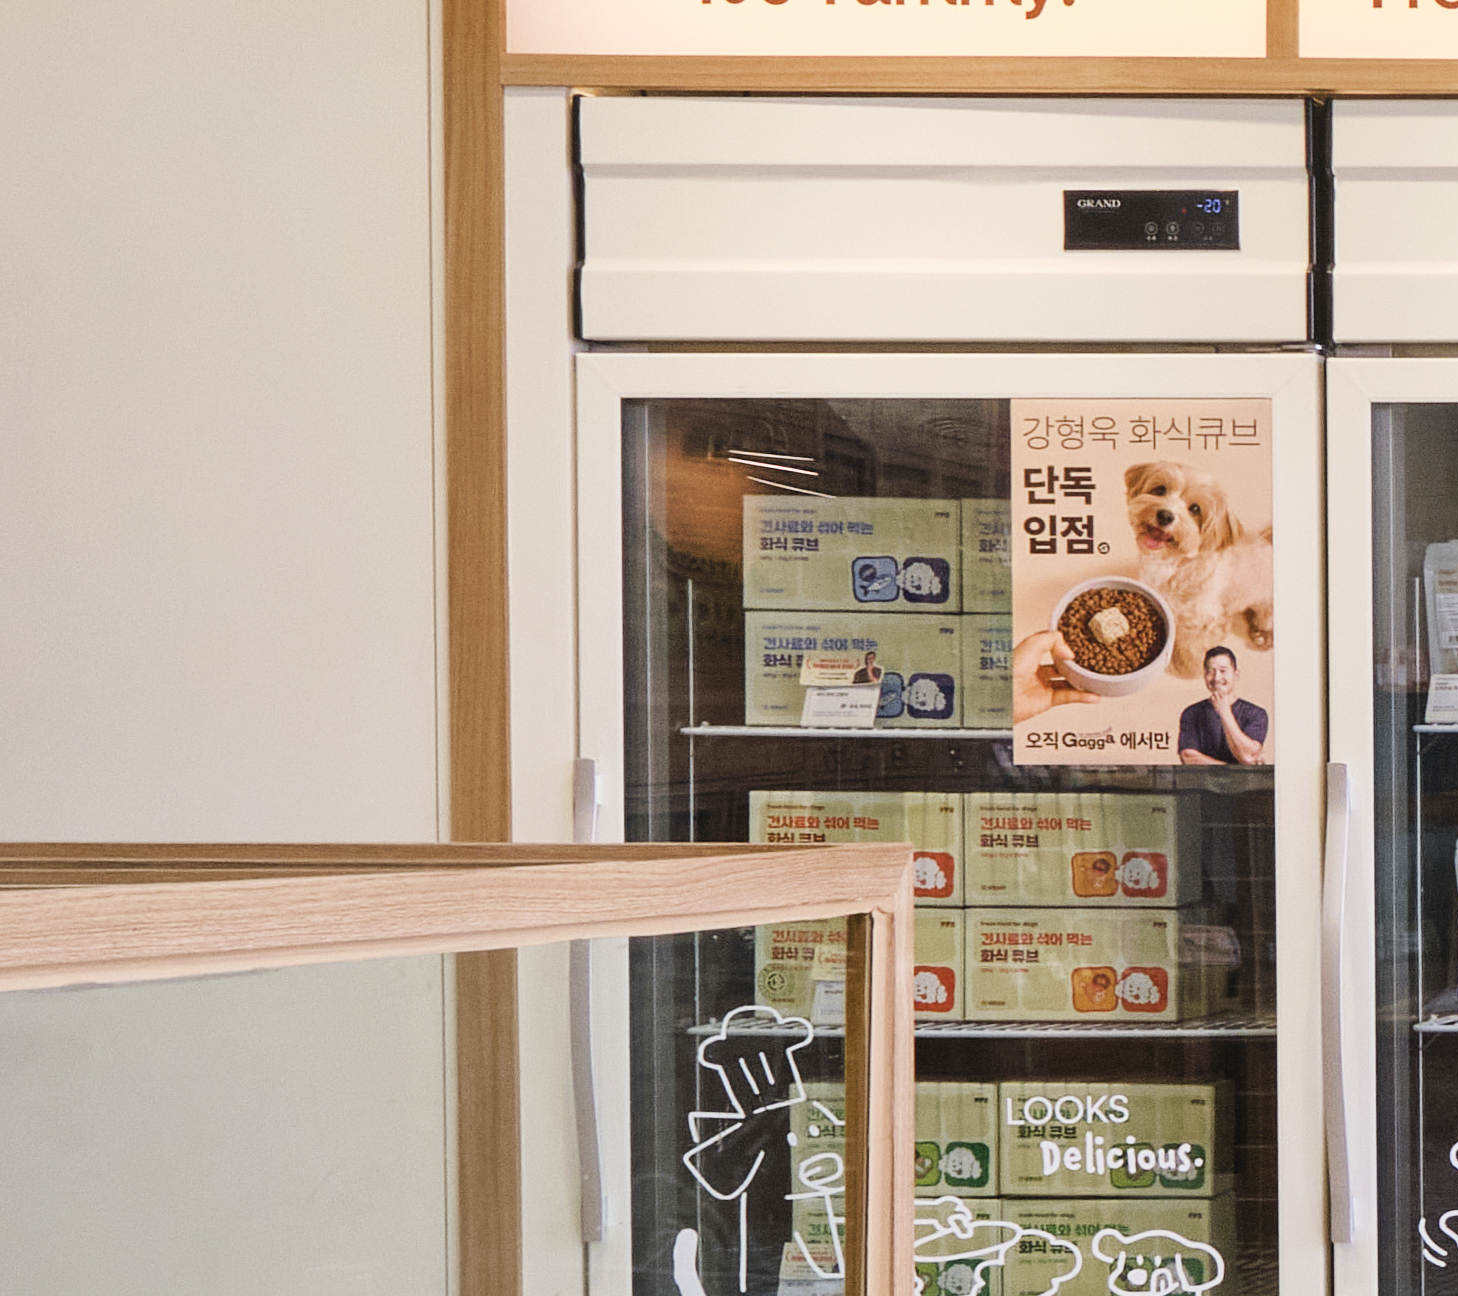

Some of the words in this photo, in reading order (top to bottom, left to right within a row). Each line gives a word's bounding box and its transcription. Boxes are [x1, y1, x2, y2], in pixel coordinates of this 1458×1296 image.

[1077, 199, 1121, 208] GRAND
[1197, 199, 1221, 213] -20
[1022, 415, 1119, 450] 강형욱
[1129, 415, 1261, 450] 화식큐브
[1023, 466, 1097, 505] 단독
[1023, 515, 1095, 555] 입점
[760, 537, 788, 552] 화식
[791, 538, 819, 552] 큐브
[763, 654, 791, 668] 화식
[1025, 733, 1060, 751] 오직
[1119, 732, 1171, 751] 에서만
[768, 816, 821, 829] 건사료와
[824, 816, 850, 830] 섞어
[853, 817, 880, 831] 먹는
[980, 817, 1033, 831] 건사료와
[1036, 817, 1063, 831] 섞어
[1066, 818, 1093, 832] 먹는
[980, 834, 1008, 848] 화식
[1012, 834, 1039, 848] 큐브
[980, 932, 1033, 946] 건사료와
[1036, 933, 1063, 946] 섞어
[1066, 933, 1093, 946] 먹는
[771, 947, 799, 961] 화식
[980, 949, 1008, 963] 화식
[1012, 949, 1039, 963] 큐브
[1006, 1094, 1130, 1125] LOOKS
[1017, 1126, 1046, 1139] 화식
[1049, 1126, 1077, 1139] 큐브
[1040, 1131, 1204, 1176] Delicious.
[1019, 1240, 1046, 1254] 화식
